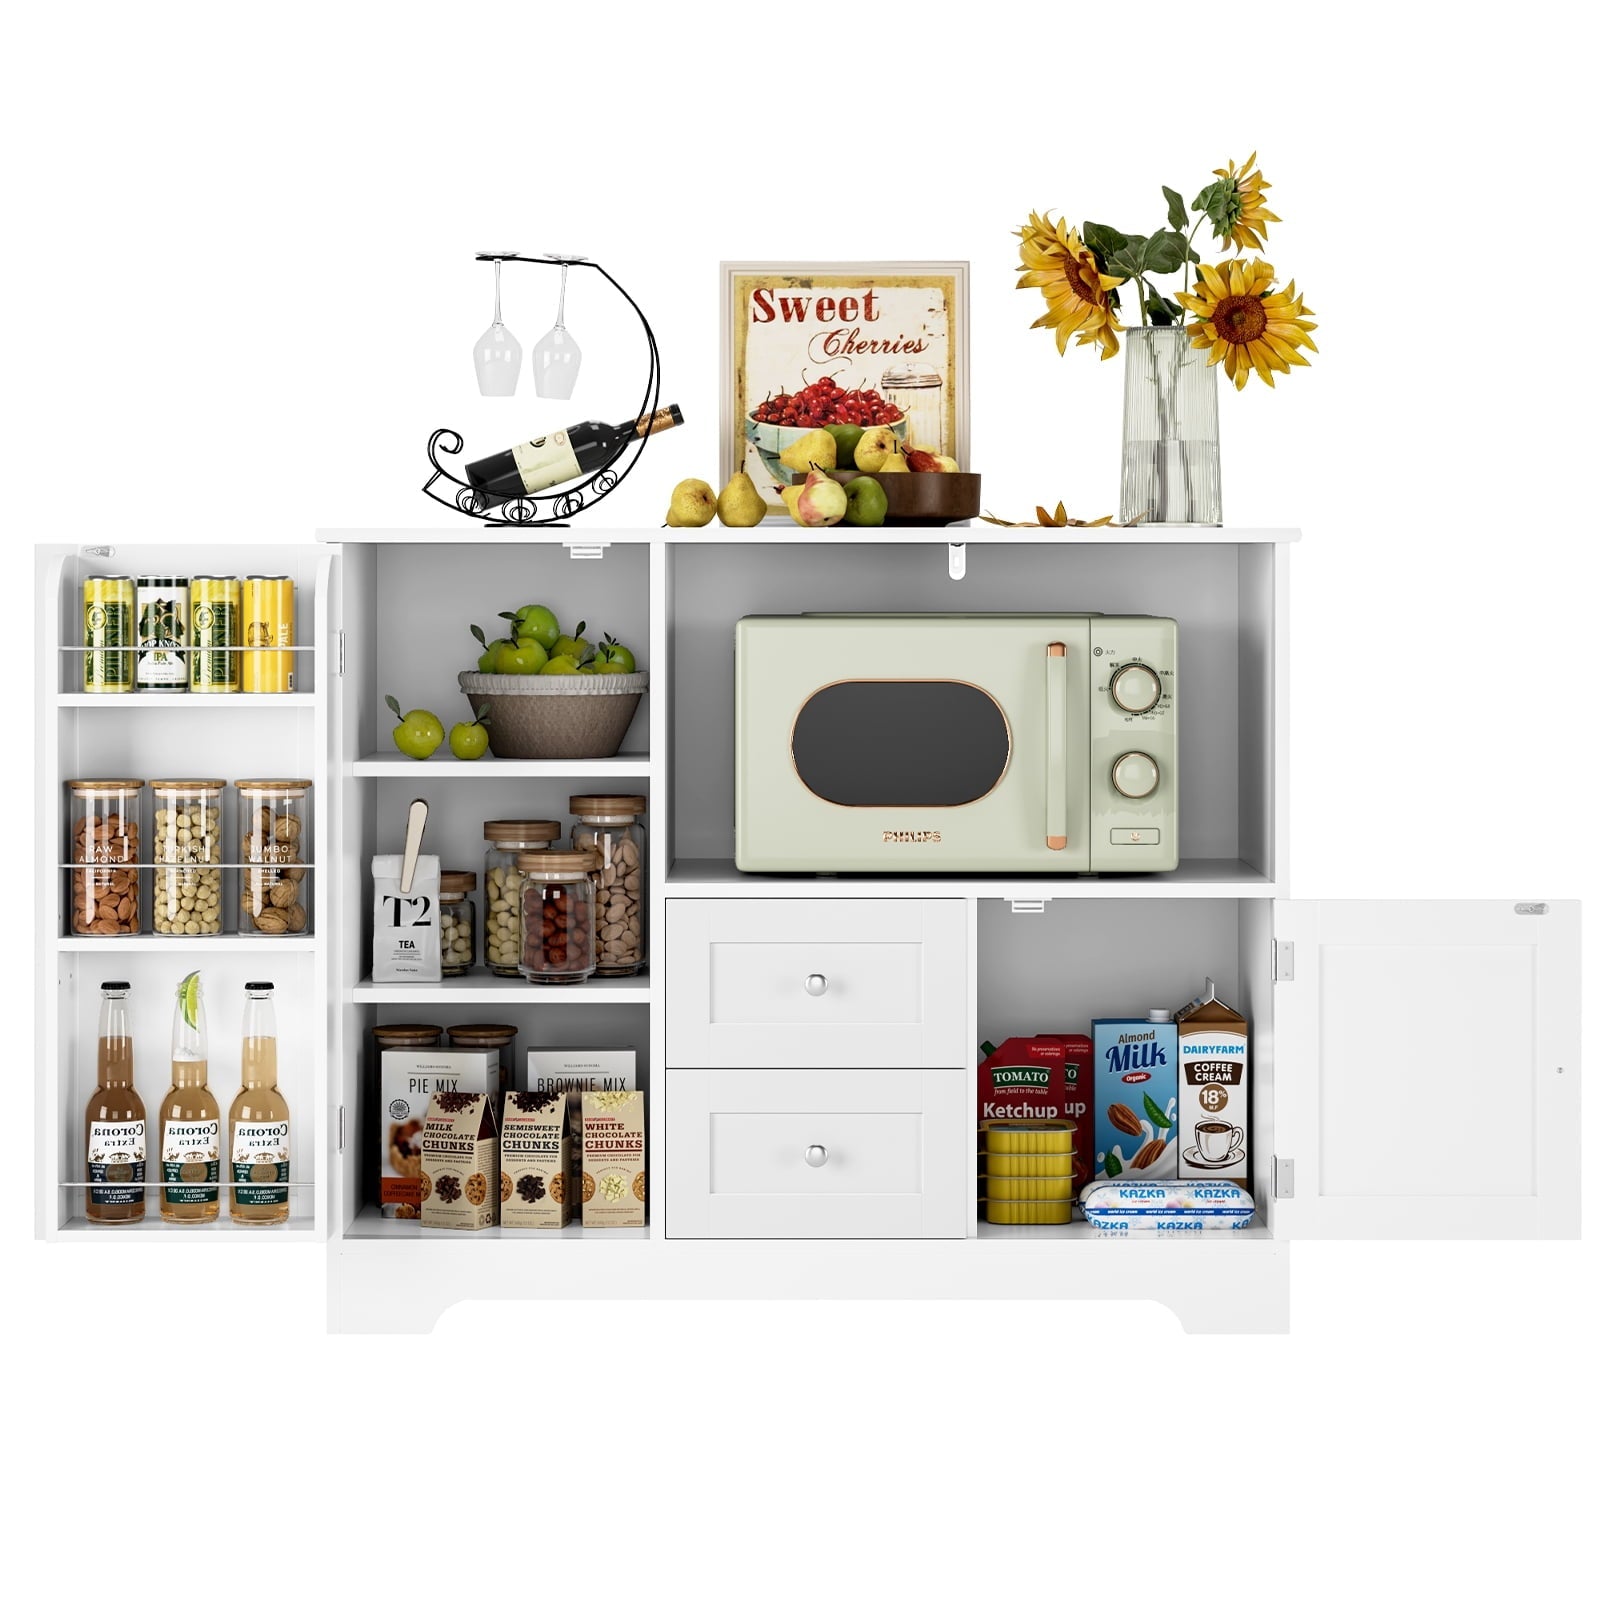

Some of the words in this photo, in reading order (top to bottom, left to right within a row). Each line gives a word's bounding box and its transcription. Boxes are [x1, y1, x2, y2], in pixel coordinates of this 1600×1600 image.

[752, 287, 880, 323] Sweet
[808, 327, 929, 365] Cherries
[153, 652, 168, 661] IPA
[882, 830, 942, 843] PHILIPS
[89, 845, 113, 853] RAW
[163, 845, 206, 853] TRKISH
[252, 845, 289, 853] JUMBO
[79, 855, 124, 863] AMOND
[159, 855, 210, 863] HELNU
[248, 855, 292, 863] WALNUT
[382, 895, 431, 928] T2
[398, 940, 415, 949] TEA
[1118, 1029, 1155, 1044] Almond
[1183, 1045, 1244, 1054] DAIRYFARM
[1105, 1041, 1167, 1073] Milk
[1194, 1063, 1233, 1072] COFFEE
[993, 1071, 1049, 1083] TOMATO
[1126, 1072, 1147, 1082] Organic
[1195, 1072, 1232, 1081] CREAM
[409, 1078, 429, 1093] PIE
[436, 1078, 458, 1093] MIX
[537, 1077, 596, 1092] BROWNIE
[603, 1077, 626, 1092] MIX
[1035, 1088, 1048, 1096] table
[1201, 1089, 1227, 1105] 18%
[983, 1101, 1058, 1119] Ketchup
[425, 1122, 454, 1131] MILK
[504, 1124, 561, 1132] SEMISWEET
[584, 1123, 625, 1131] WHITE
[423, 1131, 476, 1141] CHOCOLATE
[584, 1131, 642, 1139] CHOCOLATE
[422, 1140, 474, 1151] CHUNKS
[502, 1140, 559, 1150] CHUNKS
[584, 1140, 642, 1149] CHUNKS
[1119, 1189, 1165, 1198] KAZKA
[1194, 1189, 1240, 1198] KAZKA
